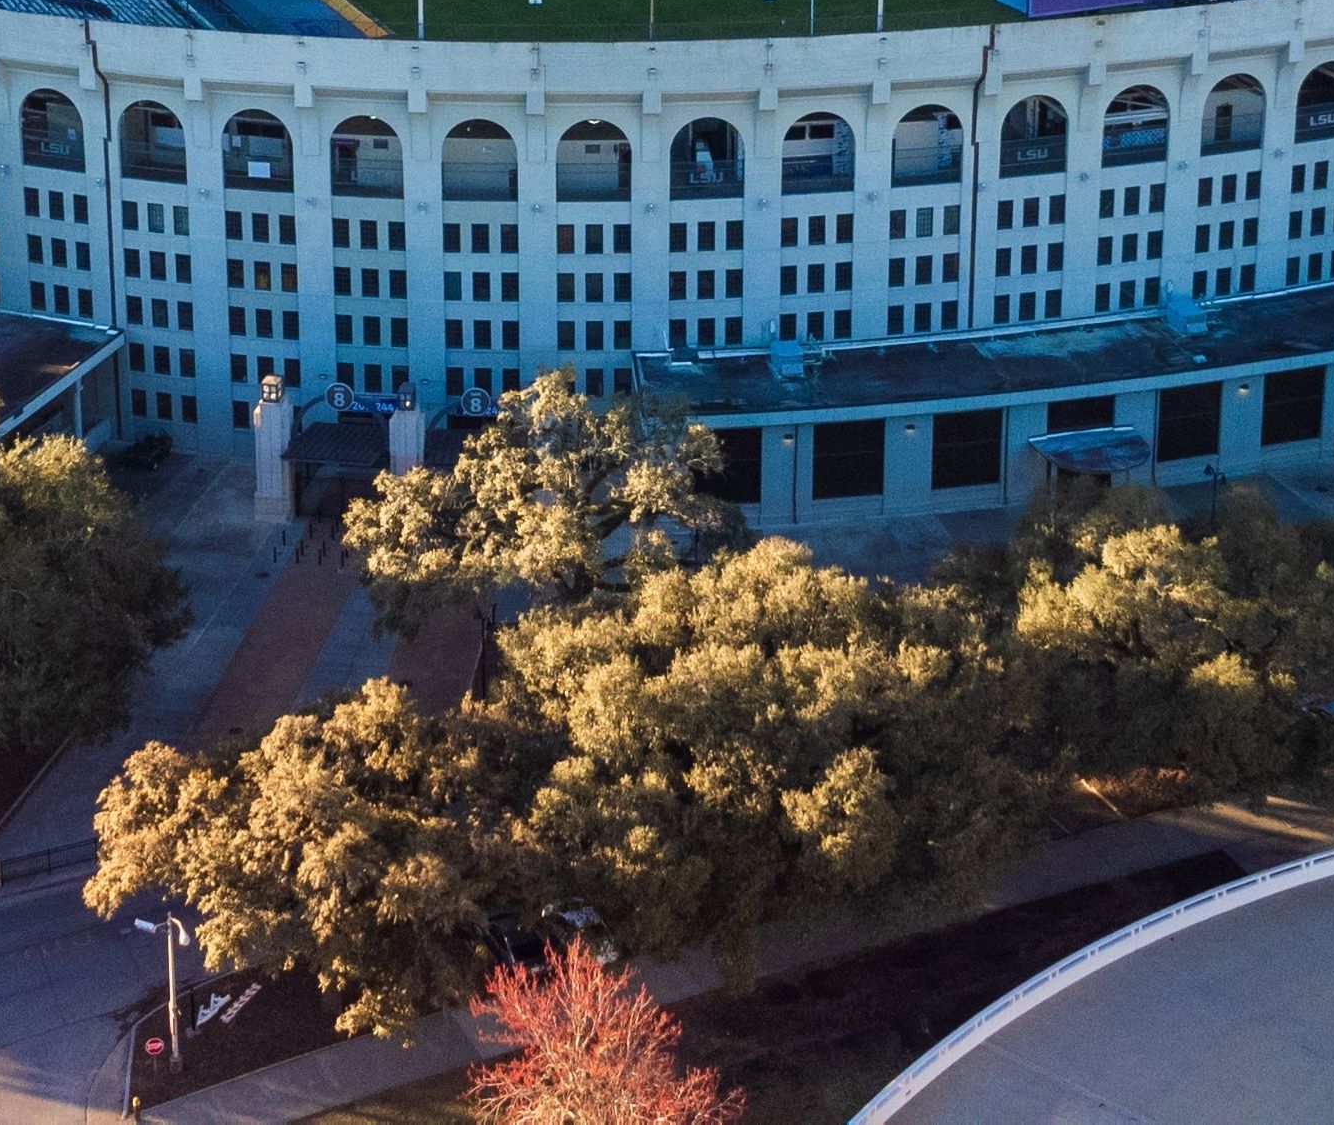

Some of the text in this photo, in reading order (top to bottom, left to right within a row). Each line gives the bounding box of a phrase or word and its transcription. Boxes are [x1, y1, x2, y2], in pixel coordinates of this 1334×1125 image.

[40, 141, 70, 156] LSU
[1016, 147, 1048, 162] LSU
[334, 392, 345, 407] 8
[470, 397, 482, 412] 8
